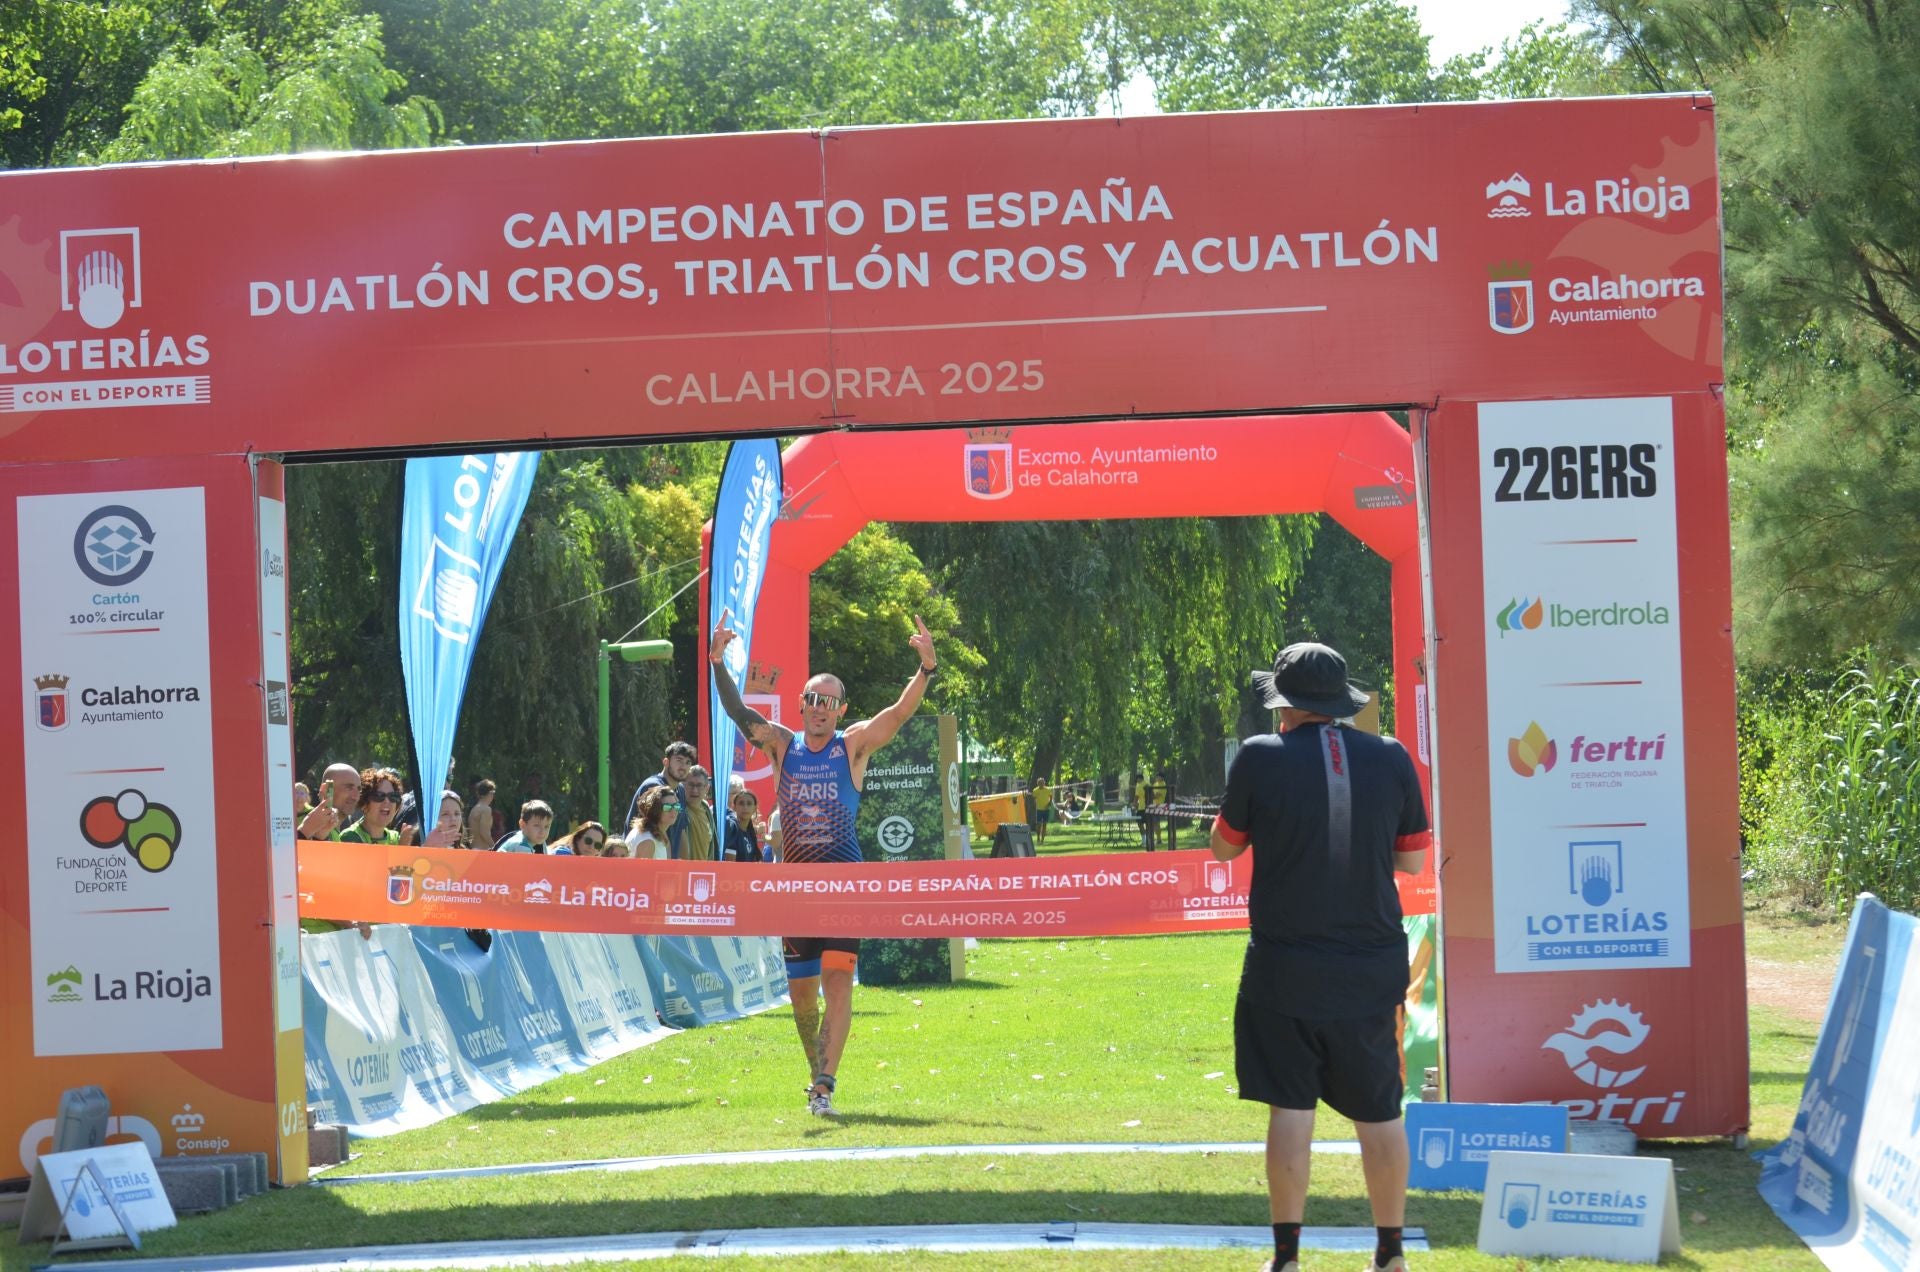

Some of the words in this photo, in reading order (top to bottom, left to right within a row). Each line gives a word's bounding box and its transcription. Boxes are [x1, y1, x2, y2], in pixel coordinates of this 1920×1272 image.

[1545, 181, 1586, 216] La
[1595, 178, 1691, 219] Rioja
[503, 199, 865, 248] CAMPEONATO
[884, 195, 949, 234] DE
[966, 177, 1174, 231] ESPAÑA
[249, 262, 489, 317] DUATLÓN
[507, 262, 659, 305] CROS,
[675, 243, 930, 297] TRIATLÓN
[948, 244, 1087, 286] CROS
[1104, 241, 1135, 278] Y
[1154, 218, 1439, 276] ACUATLÓN
[1548, 273, 1705, 303] Calahorra
[1549, 303, 1657, 325] Ayuntamiento
[0, 329, 210, 374] LOTERÍAS
[645, 365, 926, 406] CALAHORRA
[940, 359, 1045, 395] 2025
[22, 390, 64, 404] CON
[70, 388, 95, 401] EL
[98, 383, 187, 400] DEPORTE
[1018, 449, 1085, 466] Excmo.
[1091, 444, 1217, 469] Ayuntamiento
[1018, 470, 1041, 487] de
[1048, 468, 1138, 487] Calahorra
[1494, 443, 1657, 502] 226ERS
[729, 454, 766, 603] LOTERÍAS
[92, 592, 140, 606] Cartón
[69, 611, 107, 624] 100%
[110, 609, 164, 622] circular
[1551, 602, 1669, 627] Iberdrola
[81, 685, 200, 706] Calahorra
[82, 708, 164, 725] Ayuntamiento
[1570, 733, 1666, 763] fertrí
[863, 764, 934, 777] ostenibilidad
[1571, 771, 1621, 779] FEDERACIÓN
[1624, 770, 1658, 778] RIOJANA
[790, 782, 838, 800] FARIS
[866, 781, 881, 790] de
[883, 778, 922, 790] verdad
[1585, 780, 1622, 788] TRIATLÓN
[95, 867, 127, 880] RIOJA
[750, 880, 882, 893] CAMPEONATO
[888, 879, 912, 892] DE
[918, 874, 992, 892] ESPAÑA
[999, 876, 1023, 890] DE
[1029, 870, 1122, 889] TRIATLÓN
[1128, 870, 1179, 885] CROS
[75, 881, 128, 894] DEPORTE
[421, 877, 509, 896] Calahorra
[421, 893, 482, 905] Ayuntamiento
[559, 885, 585, 906] La
[592, 886, 649, 911] Rioja
[665, 902, 736, 914] LOTERÍAS
[902, 912, 1017, 926] CALAHORRA
[1023, 911, 1066, 925] 2025
[1527, 907, 1668, 936] LOTERÍAS
[1543, 944, 1572, 955] CON
[1576, 943, 1591, 954] EL
[1594, 943, 1653, 954] DEPORTE
[94, 972, 127, 1001] La
[136, 968, 212, 1002] Rioja
[347, 1046, 389, 1087] LOTERÍAS
[1519, 1091, 1686, 1125] etri
[176, 1136, 230, 1154] Consejo
[1461, 1132, 1552, 1149] LOTERÍAS
[90, 1171, 150, 1191] LTERÍAS
[1548, 1190, 1647, 1210] LOTERÍAS
[1556, 1212, 1577, 1221] CON
[1580, 1213, 1590, 1221] EL
[1592, 1214, 1634, 1224] DEPORTE
